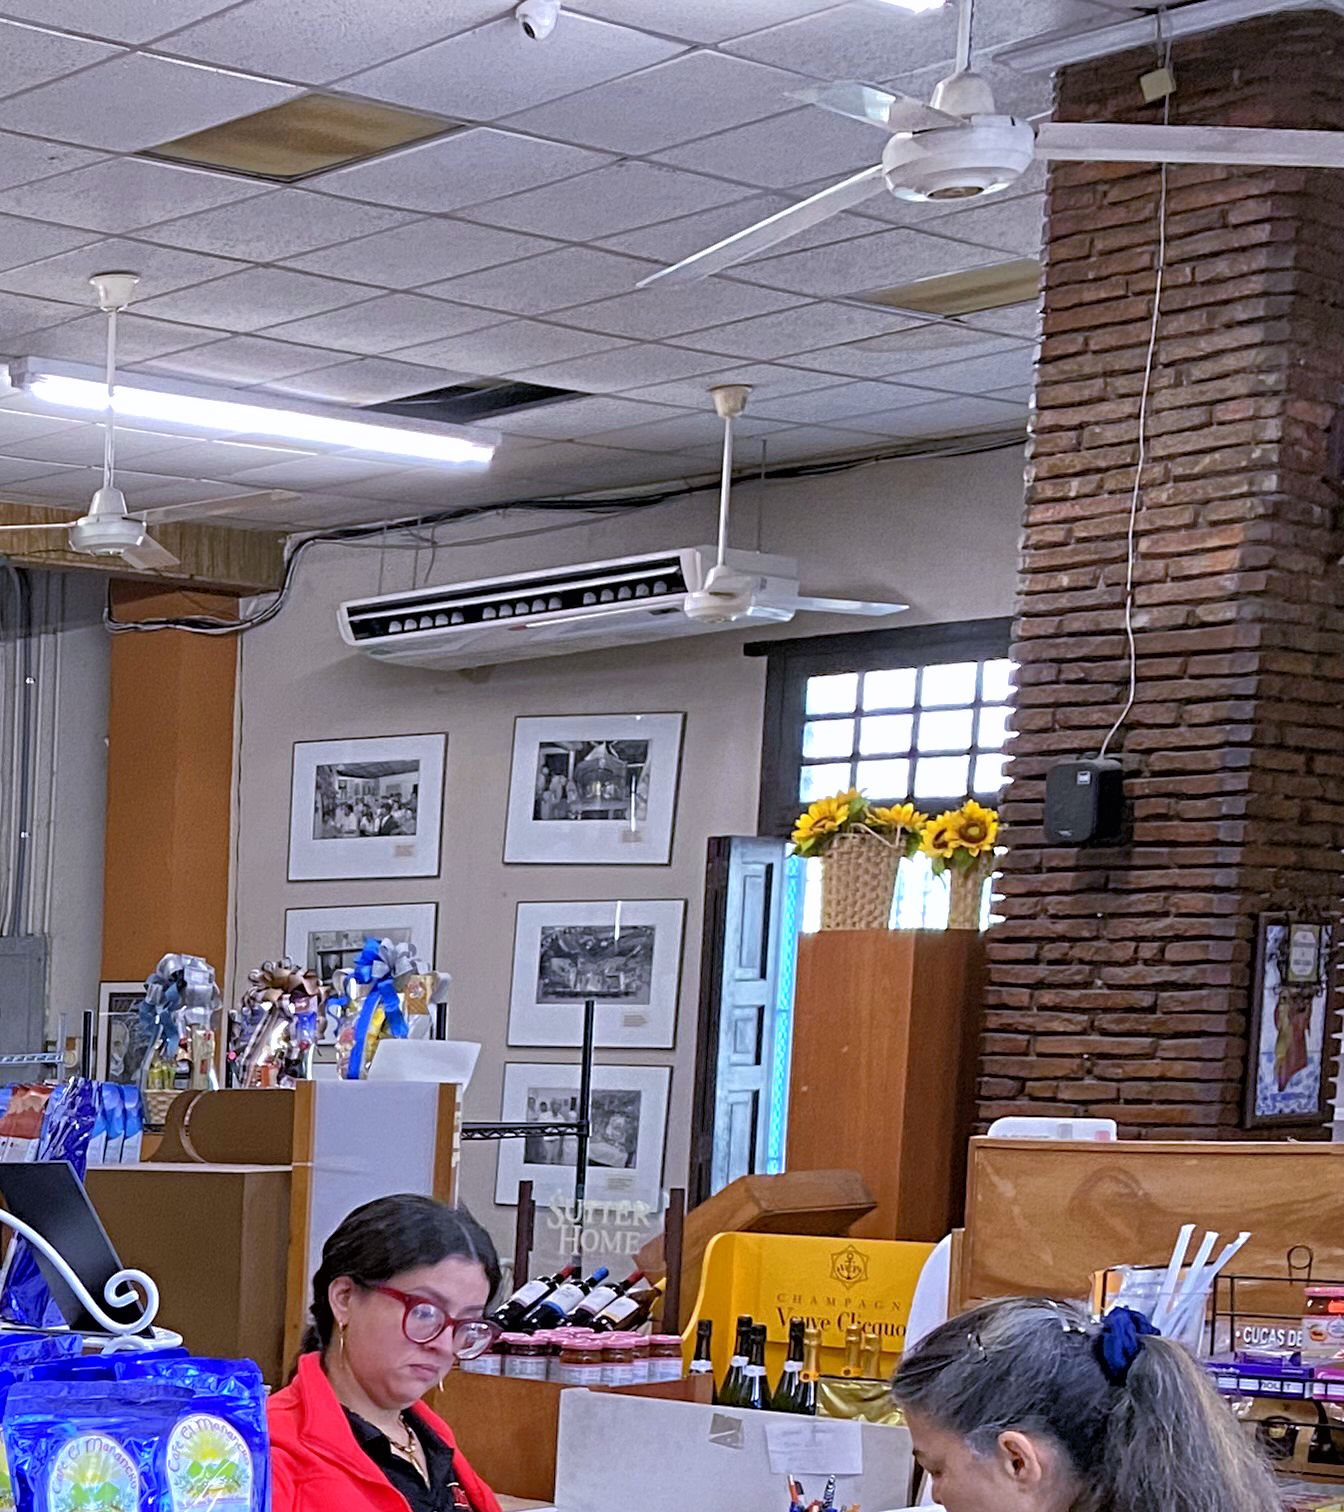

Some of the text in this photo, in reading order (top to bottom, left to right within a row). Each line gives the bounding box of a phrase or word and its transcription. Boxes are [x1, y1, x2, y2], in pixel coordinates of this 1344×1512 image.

[546, 1189, 654, 1229] SUTTER
[559, 1226, 642, 1258] HOME
[777, 1293, 902, 1312] CHAMPAGN
[837, 1311, 906, 1337] Clicquo
[1243, 1327, 1302, 1347] CUCAS DE
